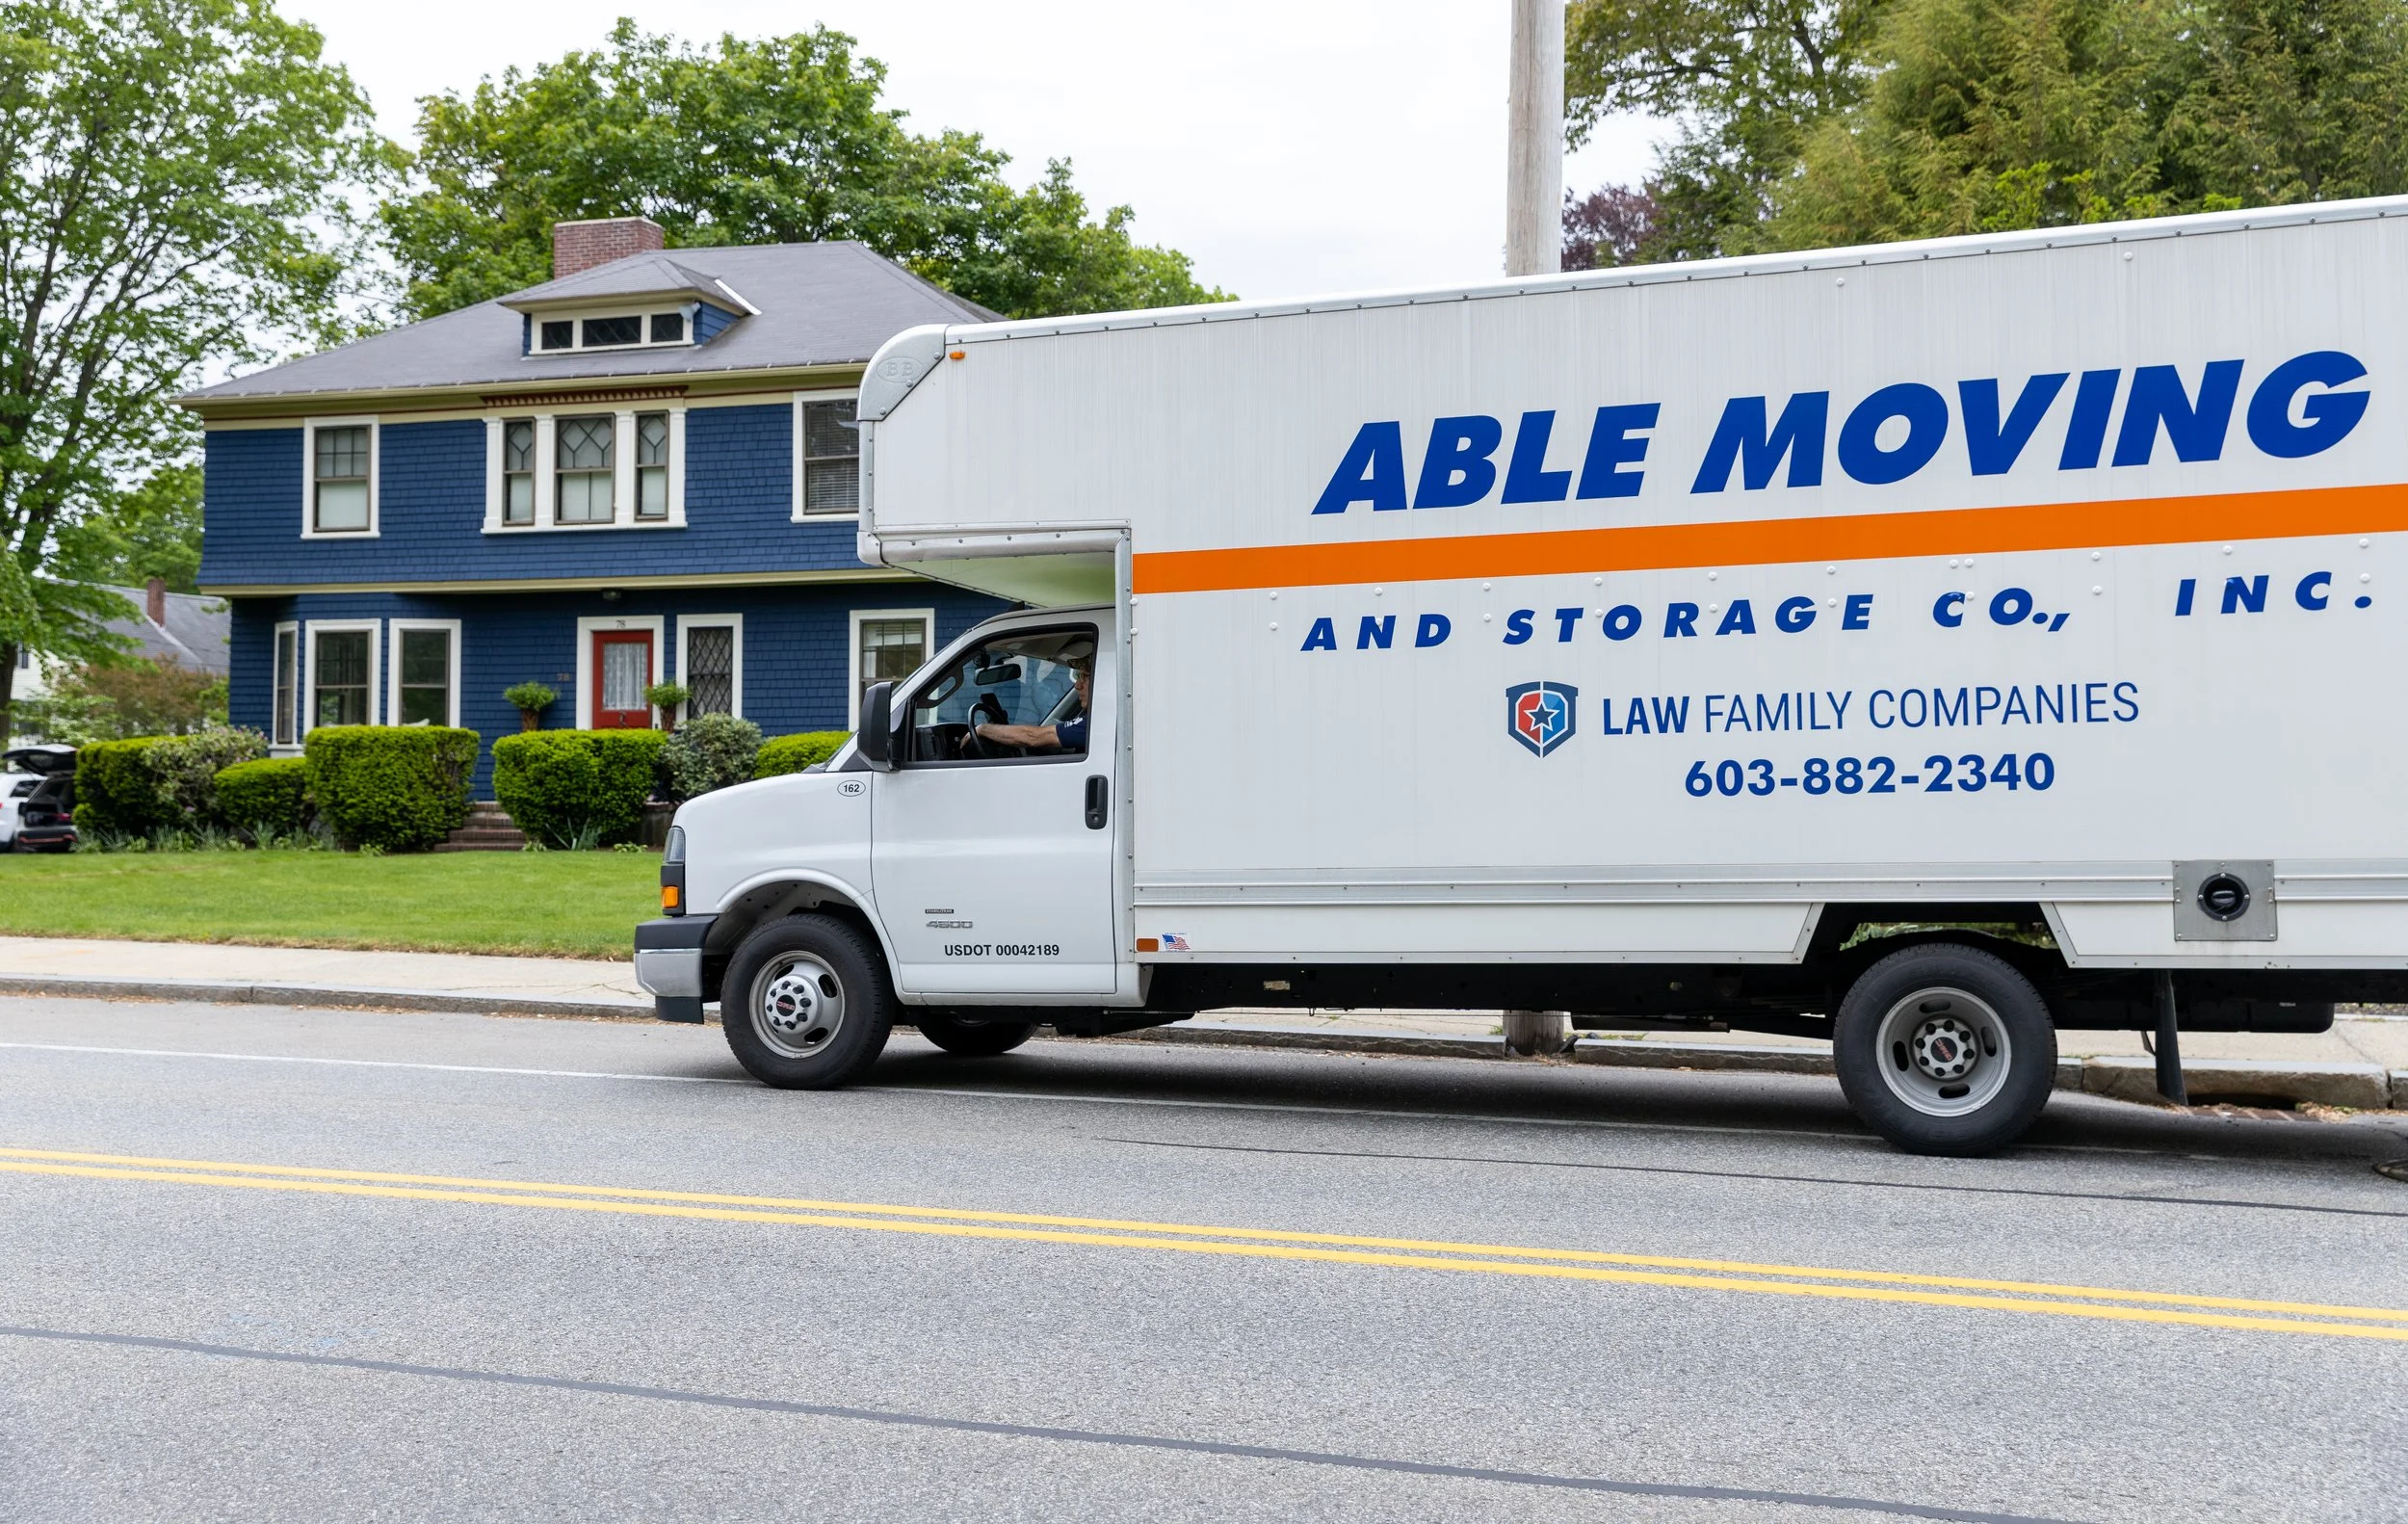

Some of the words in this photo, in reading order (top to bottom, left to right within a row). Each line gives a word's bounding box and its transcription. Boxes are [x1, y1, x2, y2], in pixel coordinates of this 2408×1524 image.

[1311, 402, 1662, 515] ABLE
[1690, 350, 2371, 494] MOVING
[616, 619, 626, 629] 78
[1300, 613, 1452, 652] AND
[1502, 591, 1874, 646] STORAGE
[1932, 586, 2070, 633] CO.,
[2174, 570, 2372, 617] INC.
[1603, 696, 1690, 736] LAW
[1705, 691, 1851, 734] FAMILY
[1868, 680, 2139, 729] COMPANIES
[843, 783, 860, 793] 162
[1685, 751, 2055, 798] 603-882-2340
[944, 944, 992, 956] USDOT
[996, 944, 1060, 956] 00042189
